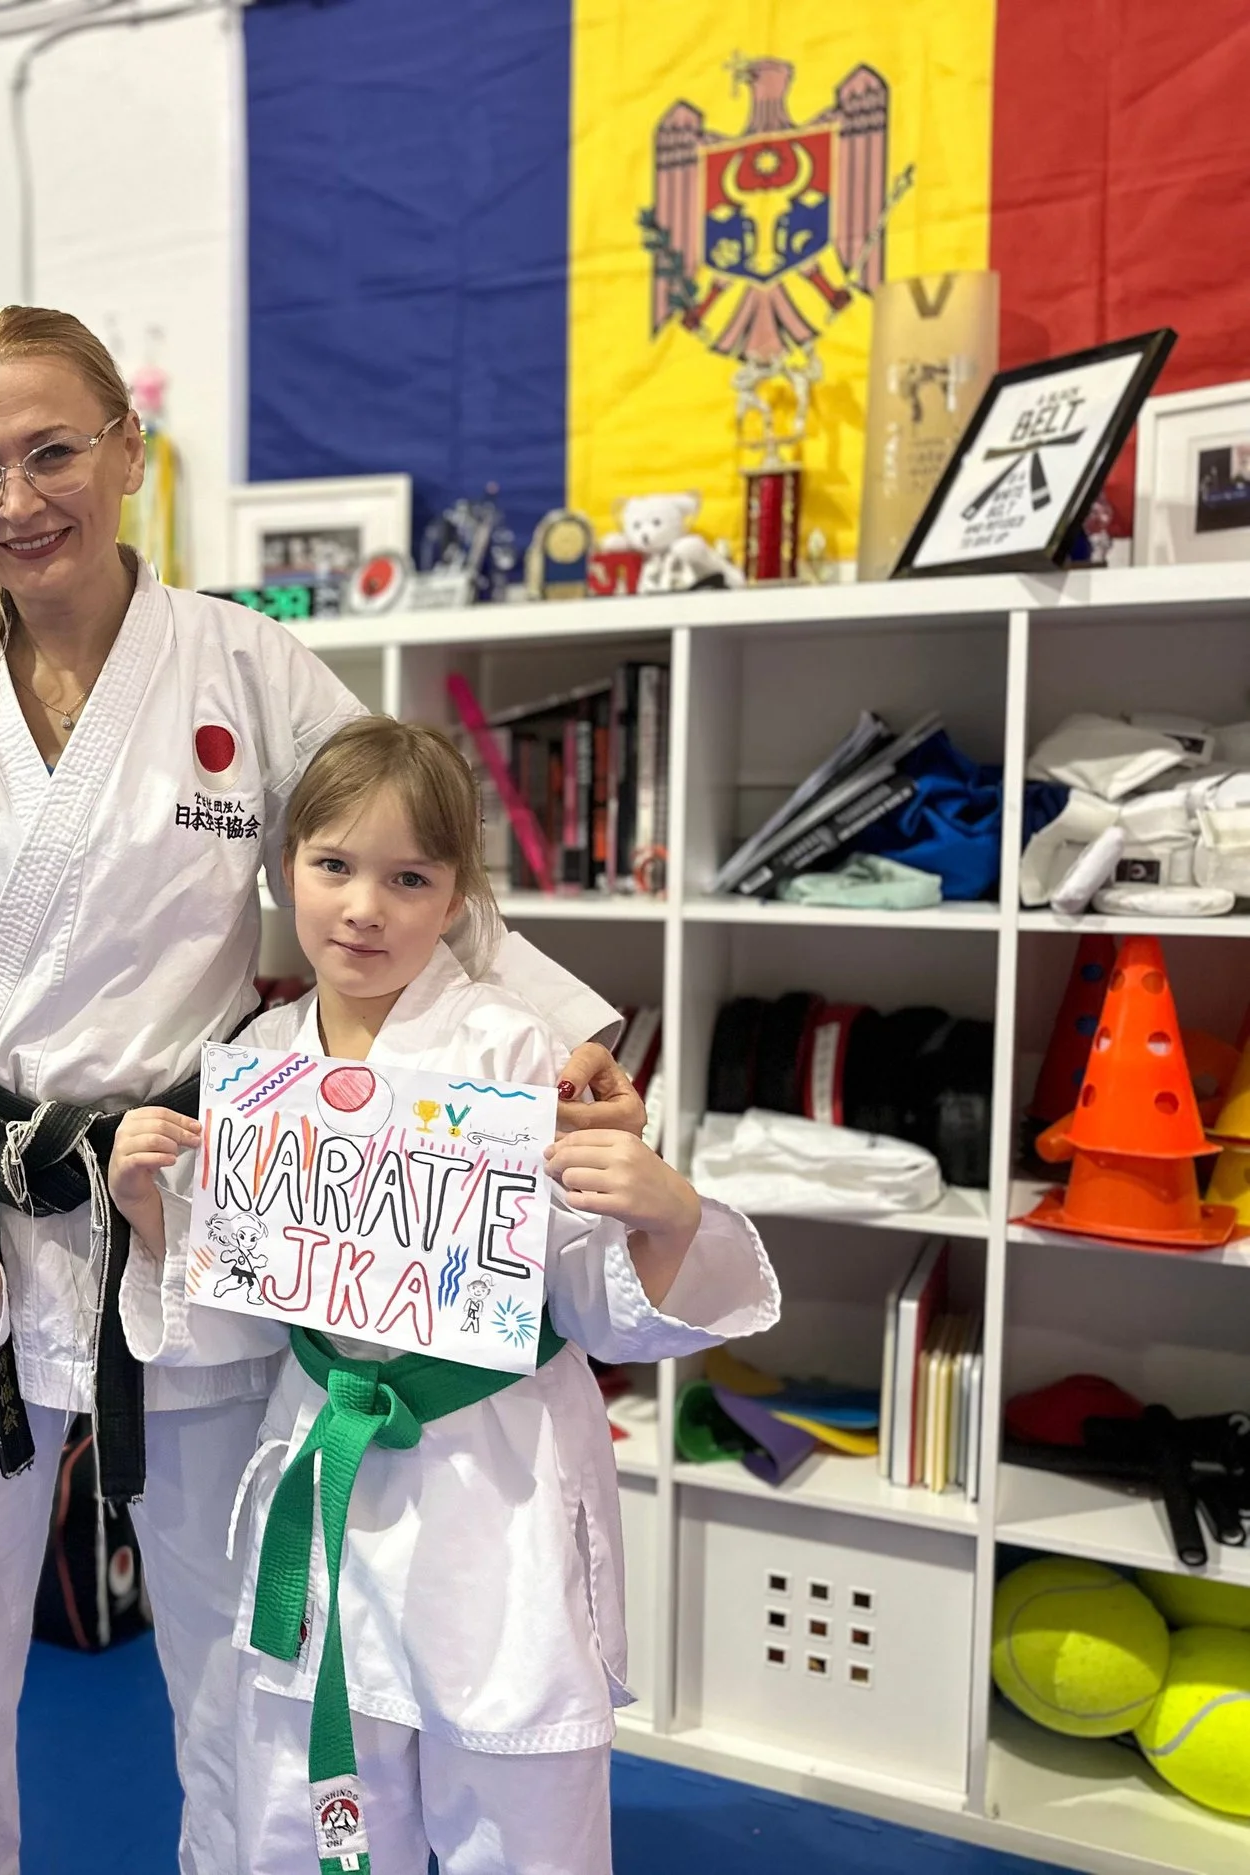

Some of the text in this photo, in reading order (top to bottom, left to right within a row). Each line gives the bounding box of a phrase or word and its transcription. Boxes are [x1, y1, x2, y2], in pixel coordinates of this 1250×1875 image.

[1010, 397, 1086, 442] BELT
[213, 1117, 537, 1279] KARATE
[262, 1225, 434, 1346] JKA
